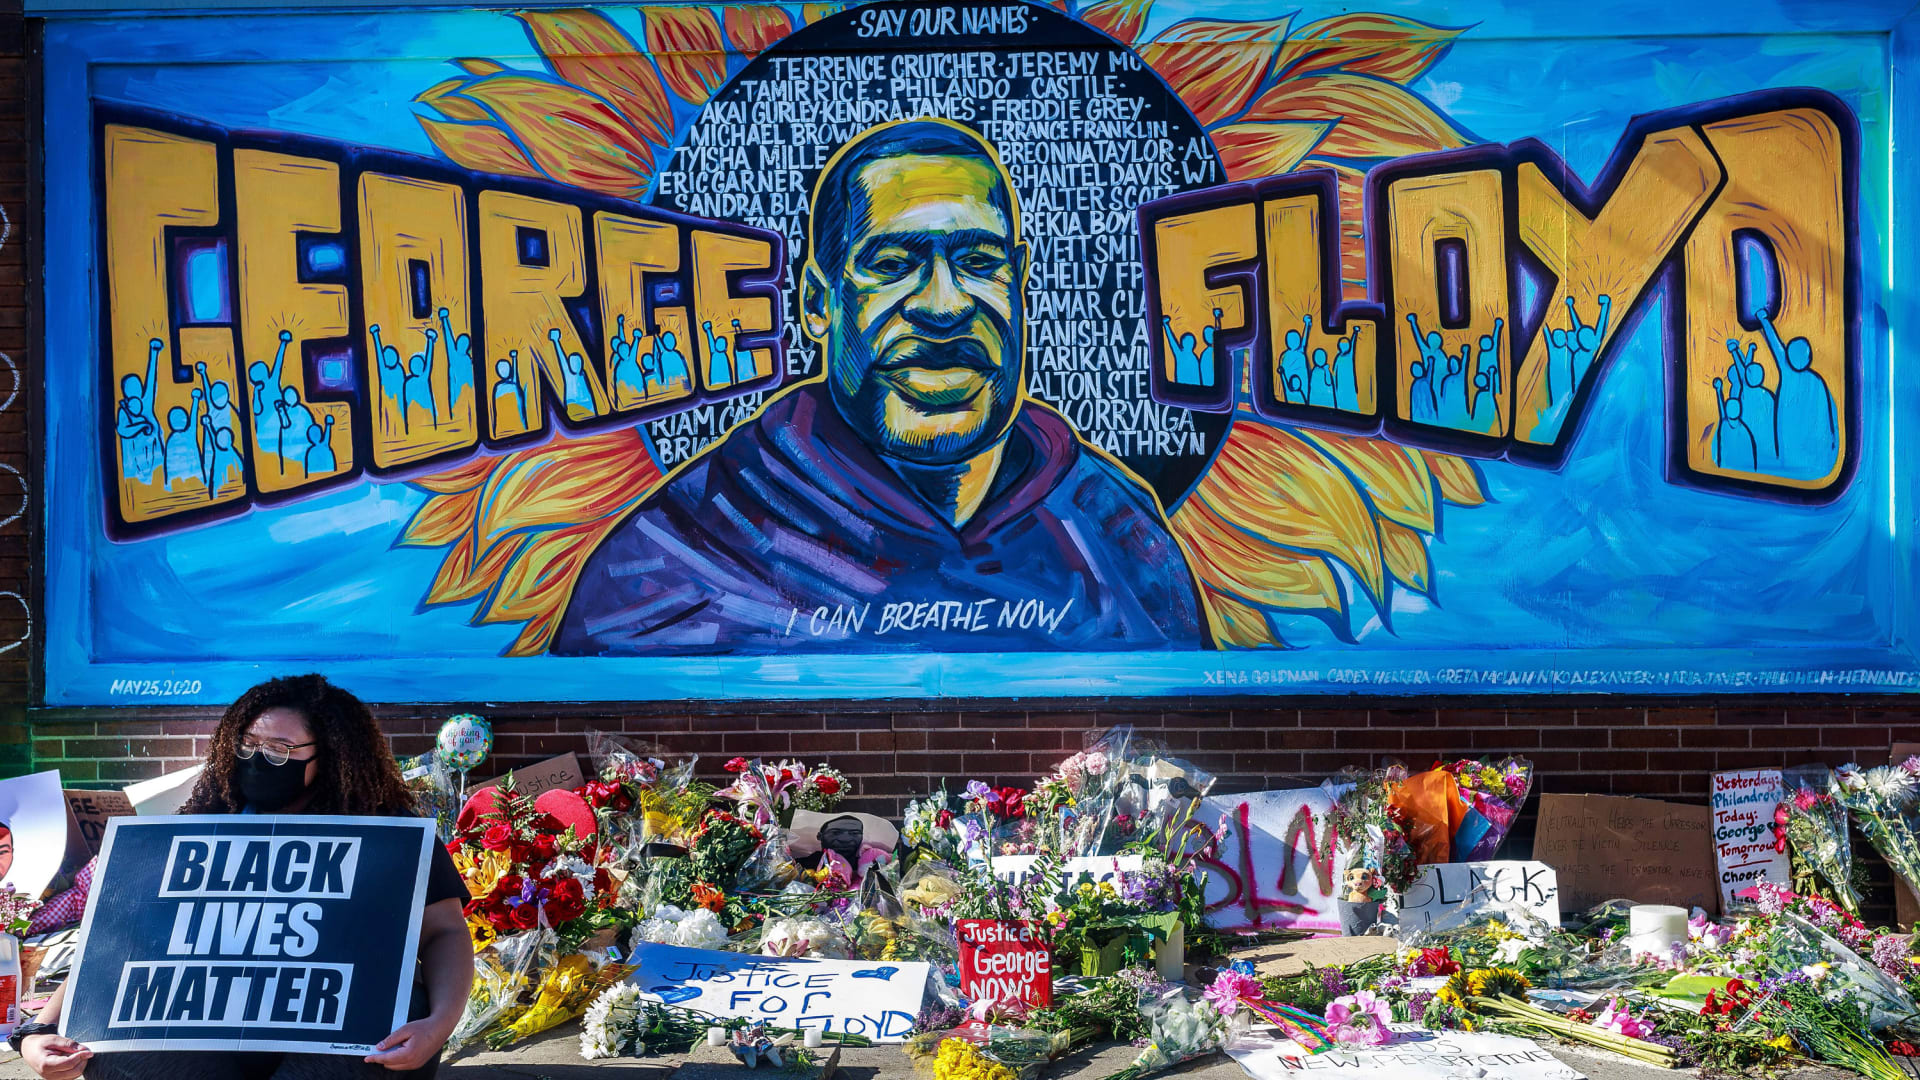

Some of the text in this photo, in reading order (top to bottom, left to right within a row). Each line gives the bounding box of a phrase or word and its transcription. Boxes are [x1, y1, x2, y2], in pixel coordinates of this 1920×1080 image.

[857, 6, 1029, 37] SAY OUR NAMES
[769, 55, 887, 81] TERRENCE
[891, 52, 997, 79] CRUTCHER
[1005, 51, 1099, 78] JEREMY
[740, 76, 1118, 102] TAMIR RICE PHILANDO CASTILE
[700, 101, 747, 125] AKAI
[902, 97, 975, 121] JAMES
[991, 99, 1081, 121] FREDDIE
[1086, 97, 1144, 121] GREY
[690, 124, 786, 147] MICHAEL
[977, 120, 1168, 142] TERRANCE FRANKLIN
[674, 144, 830, 173] TYISHA MILLE
[998, 140, 1097, 165] BREONNA
[1093, 139, 1176, 163] TAYLOR
[658, 170, 809, 195] ERIC GARNER
[1009, 163, 1108, 188] SHANTEL
[1109, 161, 1173, 187] DAVIS
[674, 192, 810, 218] SANDRA BLA
[1015, 186, 1107, 212] WALTER
[1020, 211, 1086, 237] REKIA
[1027, 262, 1108, 291] SHELLY
[1024, 290, 1107, 321] JAMAR
[1155, 106, 1847, 490] FLOYD
[102, 120, 774, 525] GEORGE
[1026, 319, 1127, 347] TANISHA
[1026, 346, 1112, 372] TARIKA
[1027, 370, 1149, 401] ALTON STE
[1058, 399, 1196, 432] KORRYNGA
[1090, 430, 1206, 456] KATHRYN
[785, 597, 1076, 637] I CAN BREATHE NOW
[1716, 771, 1780, 792] Yesterday:
[1715, 809, 1759, 827] Today:
[1716, 823, 1766, 843] George
[1718, 841, 1777, 858] Tomorrow
[166, 839, 354, 894] BLACK
[166, 901, 323, 957] LIVES
[964, 921, 1030, 943] Justice
[974, 944, 1049, 983] George
[116, 966, 345, 1023] MATTER
[1276, 1054, 1360, 1069] NEW
